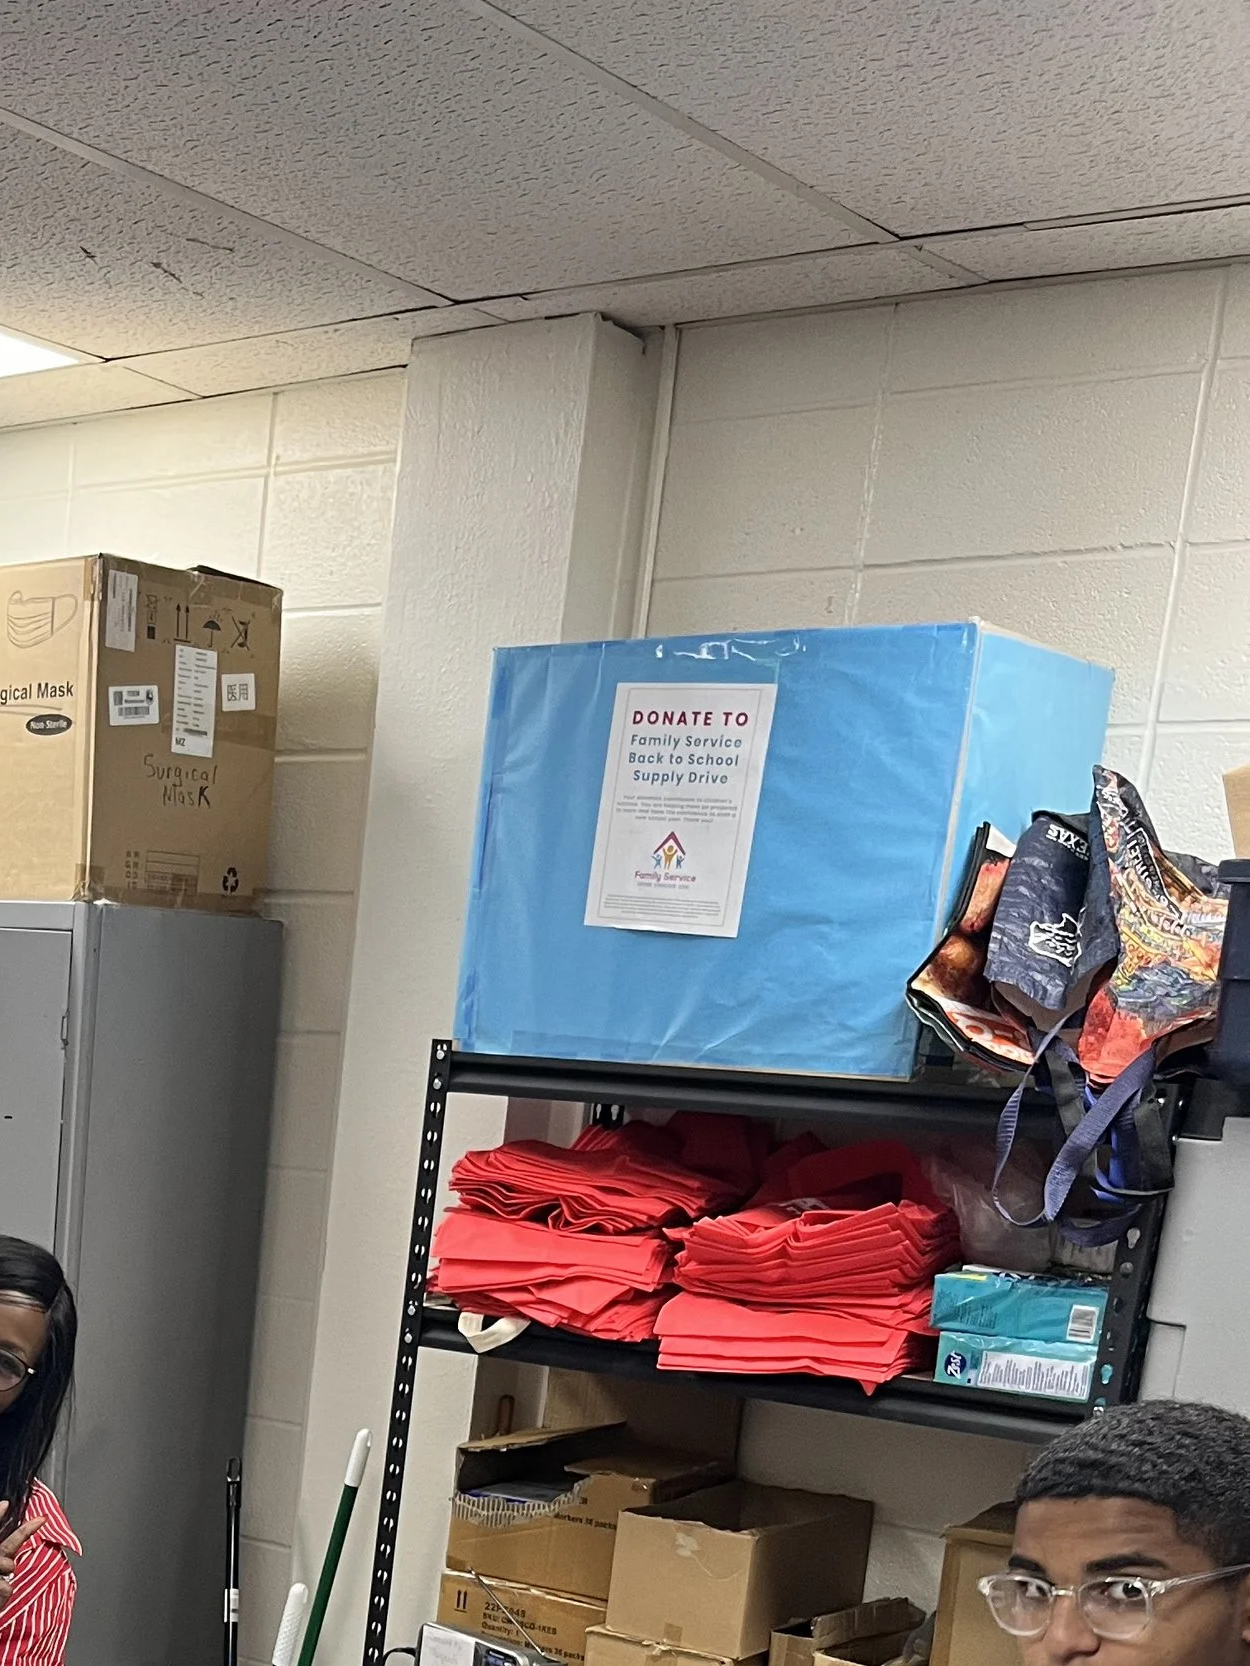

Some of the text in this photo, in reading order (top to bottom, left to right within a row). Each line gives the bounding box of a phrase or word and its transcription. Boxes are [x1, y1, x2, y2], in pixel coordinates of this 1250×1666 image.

[37, 681, 74, 699] Mask
[30, 719, 68, 730] Non-Sterile
[633, 711, 748, 726] DONATE TO
[631, 734, 742, 750] Family Service
[629, 752, 739, 766] Back to School
[144, 754, 217, 786] Surgical
[633, 770, 728, 786] Supply Drive
[634, 870, 696, 883] Family Service
[946, 1350, 962, 1379] Zest
